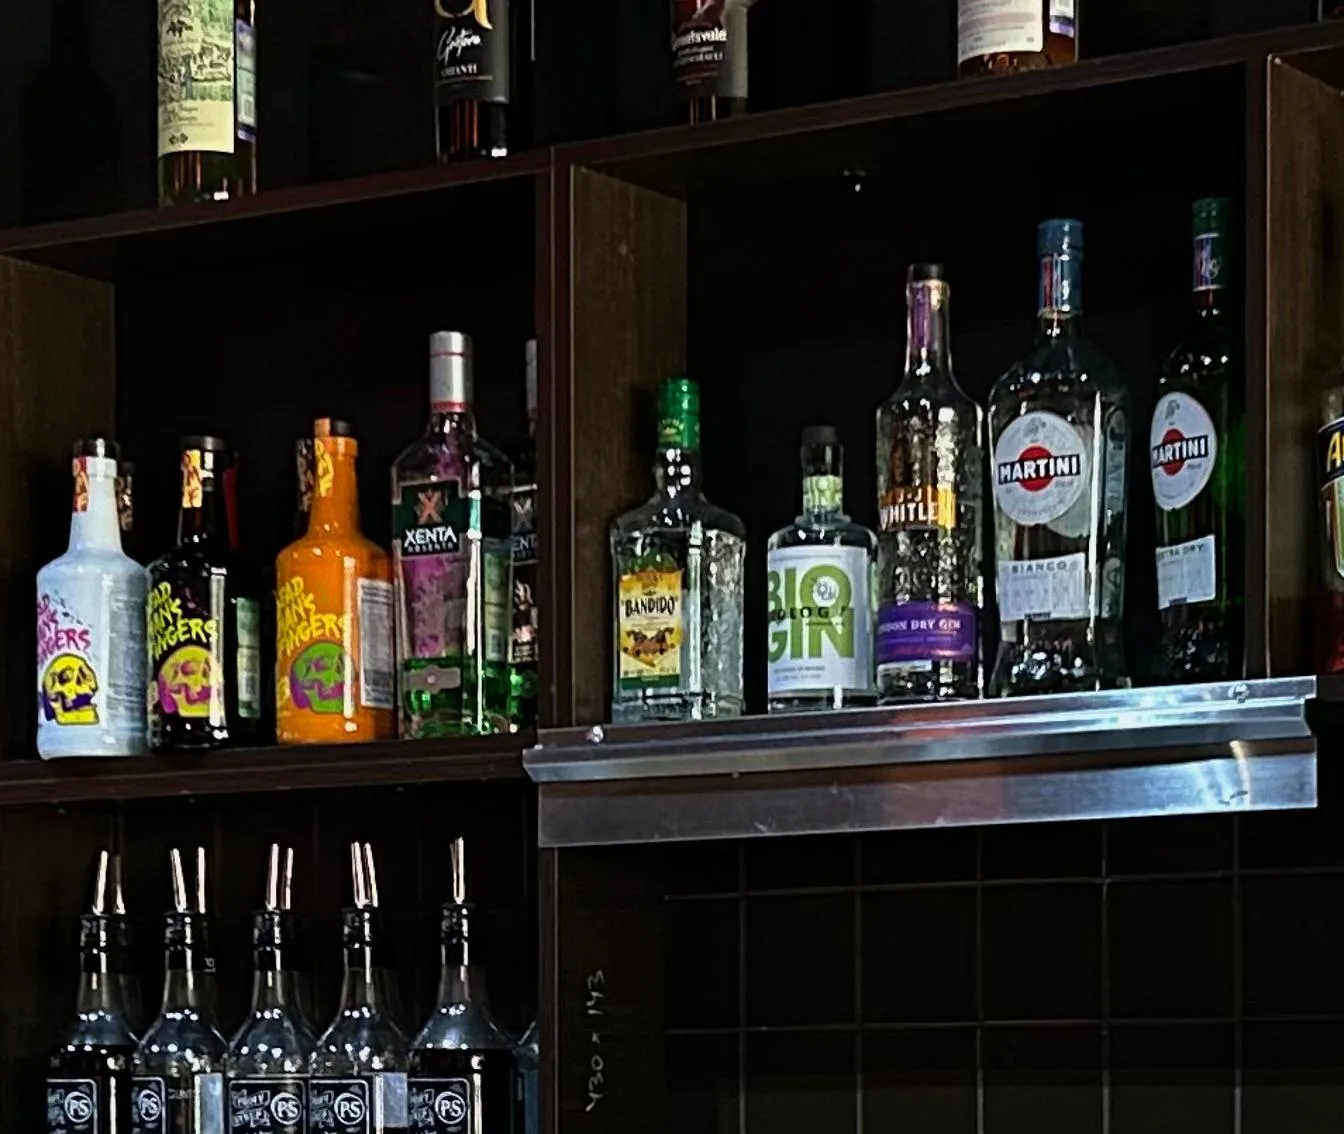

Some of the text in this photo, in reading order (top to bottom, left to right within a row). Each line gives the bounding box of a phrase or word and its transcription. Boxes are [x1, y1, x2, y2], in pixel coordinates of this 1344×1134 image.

[998, 455, 1080, 484] MARTINI
[404, 525, 457, 548] XENTA
[1011, 560, 1068, 576] BIANCO
[768, 607, 854, 663] GIN
